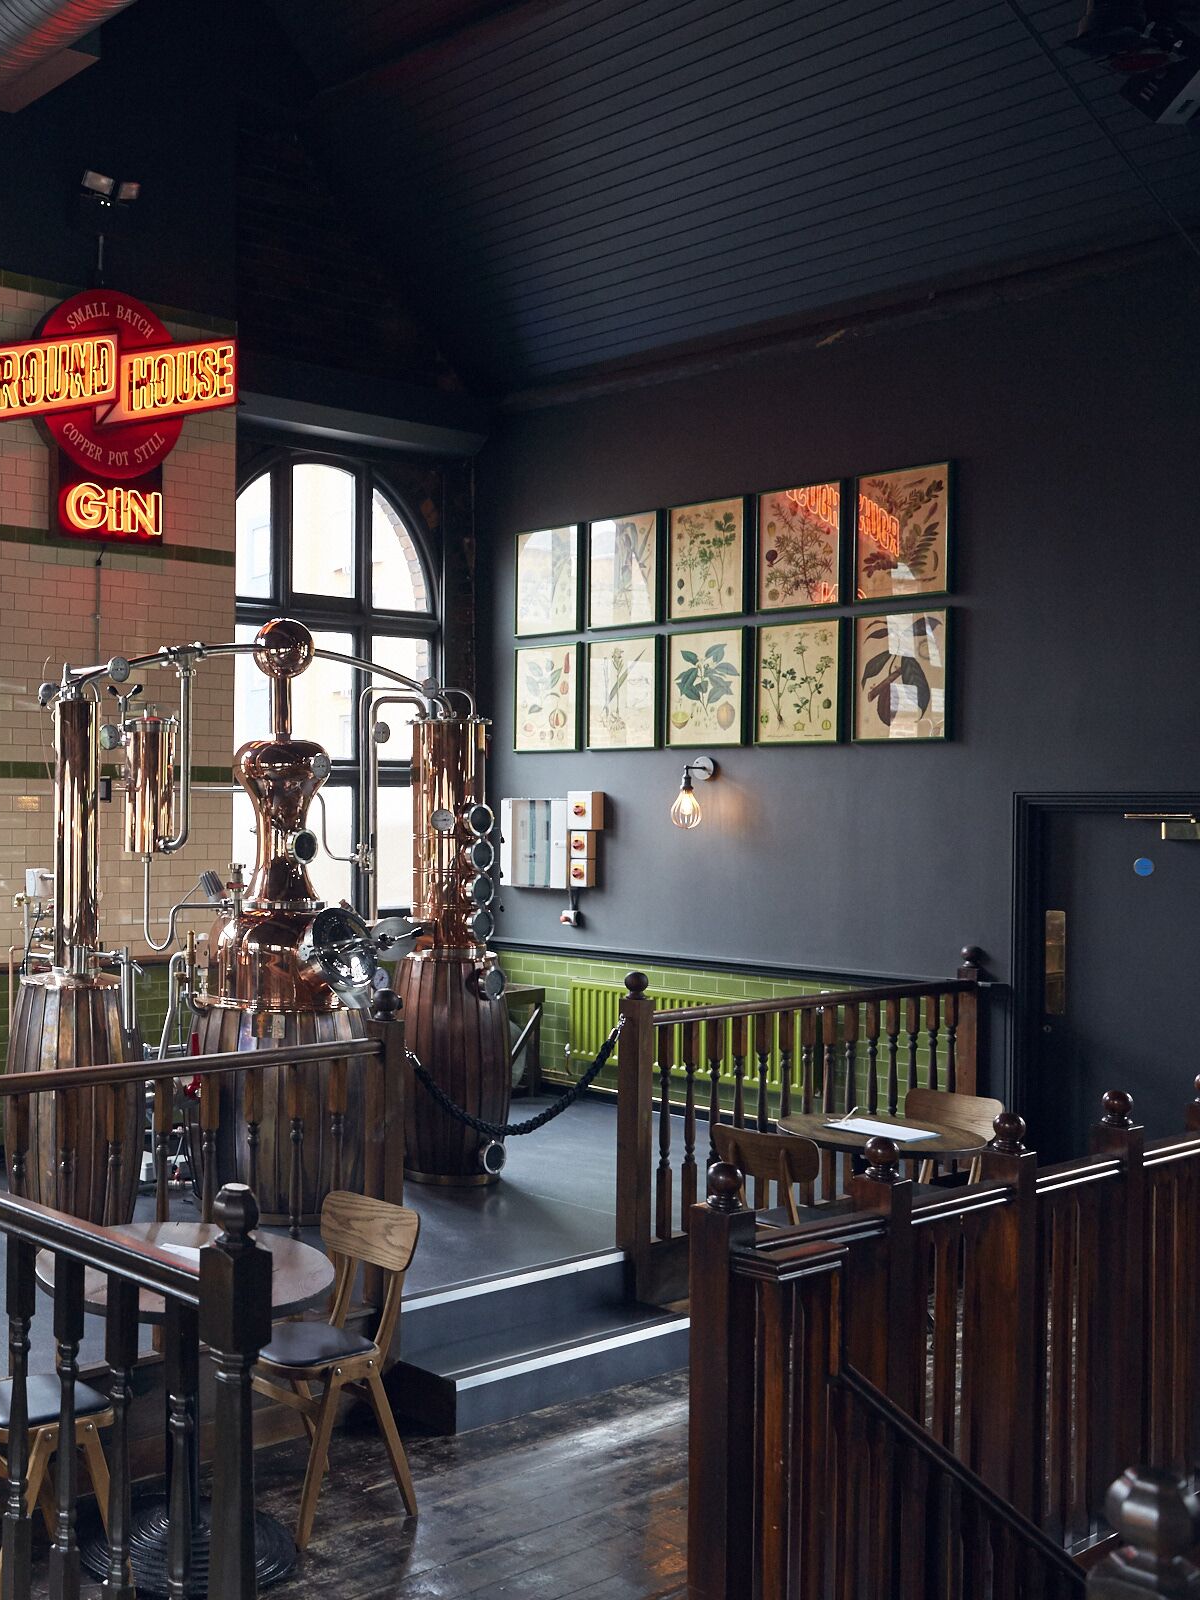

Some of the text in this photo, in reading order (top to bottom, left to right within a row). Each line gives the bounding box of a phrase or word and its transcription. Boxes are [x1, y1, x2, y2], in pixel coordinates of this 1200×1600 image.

[66, 302, 155, 340] SMALL BATCH
[128, 345, 235, 412] HOUSE
[63, 422, 166, 467] COPPER POT STILL
[66, 482, 163, 536] GIN
